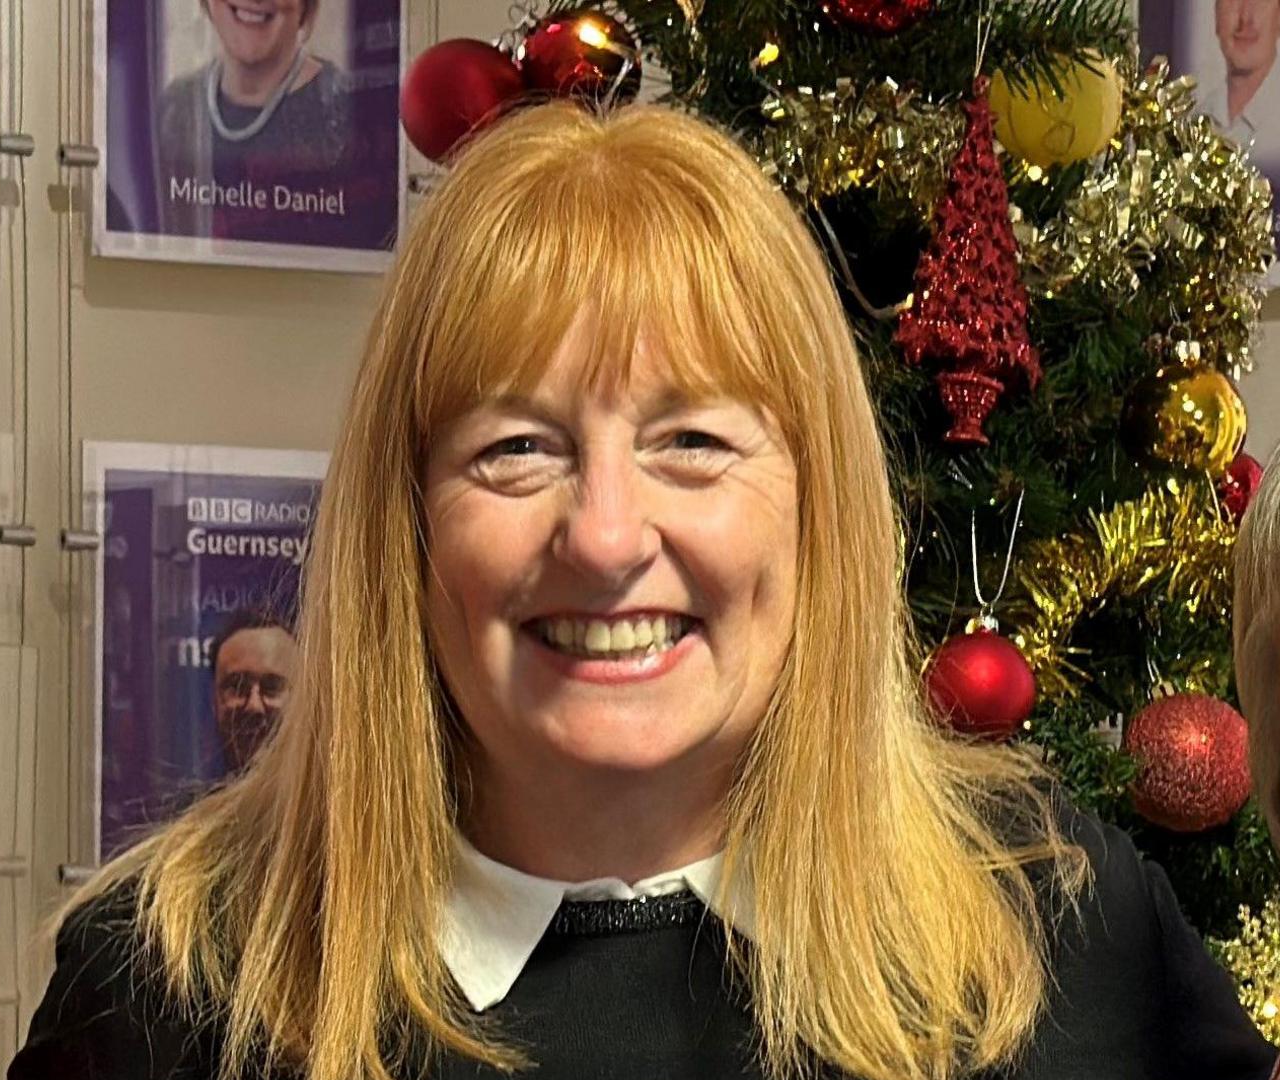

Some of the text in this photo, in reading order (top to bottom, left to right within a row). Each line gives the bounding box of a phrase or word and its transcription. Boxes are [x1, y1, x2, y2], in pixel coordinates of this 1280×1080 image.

[169, 176, 345, 216] Michelle Daniel
[191, 498, 310, 523] BBC RADIO
[187, 527, 308, 566] Guernsey
